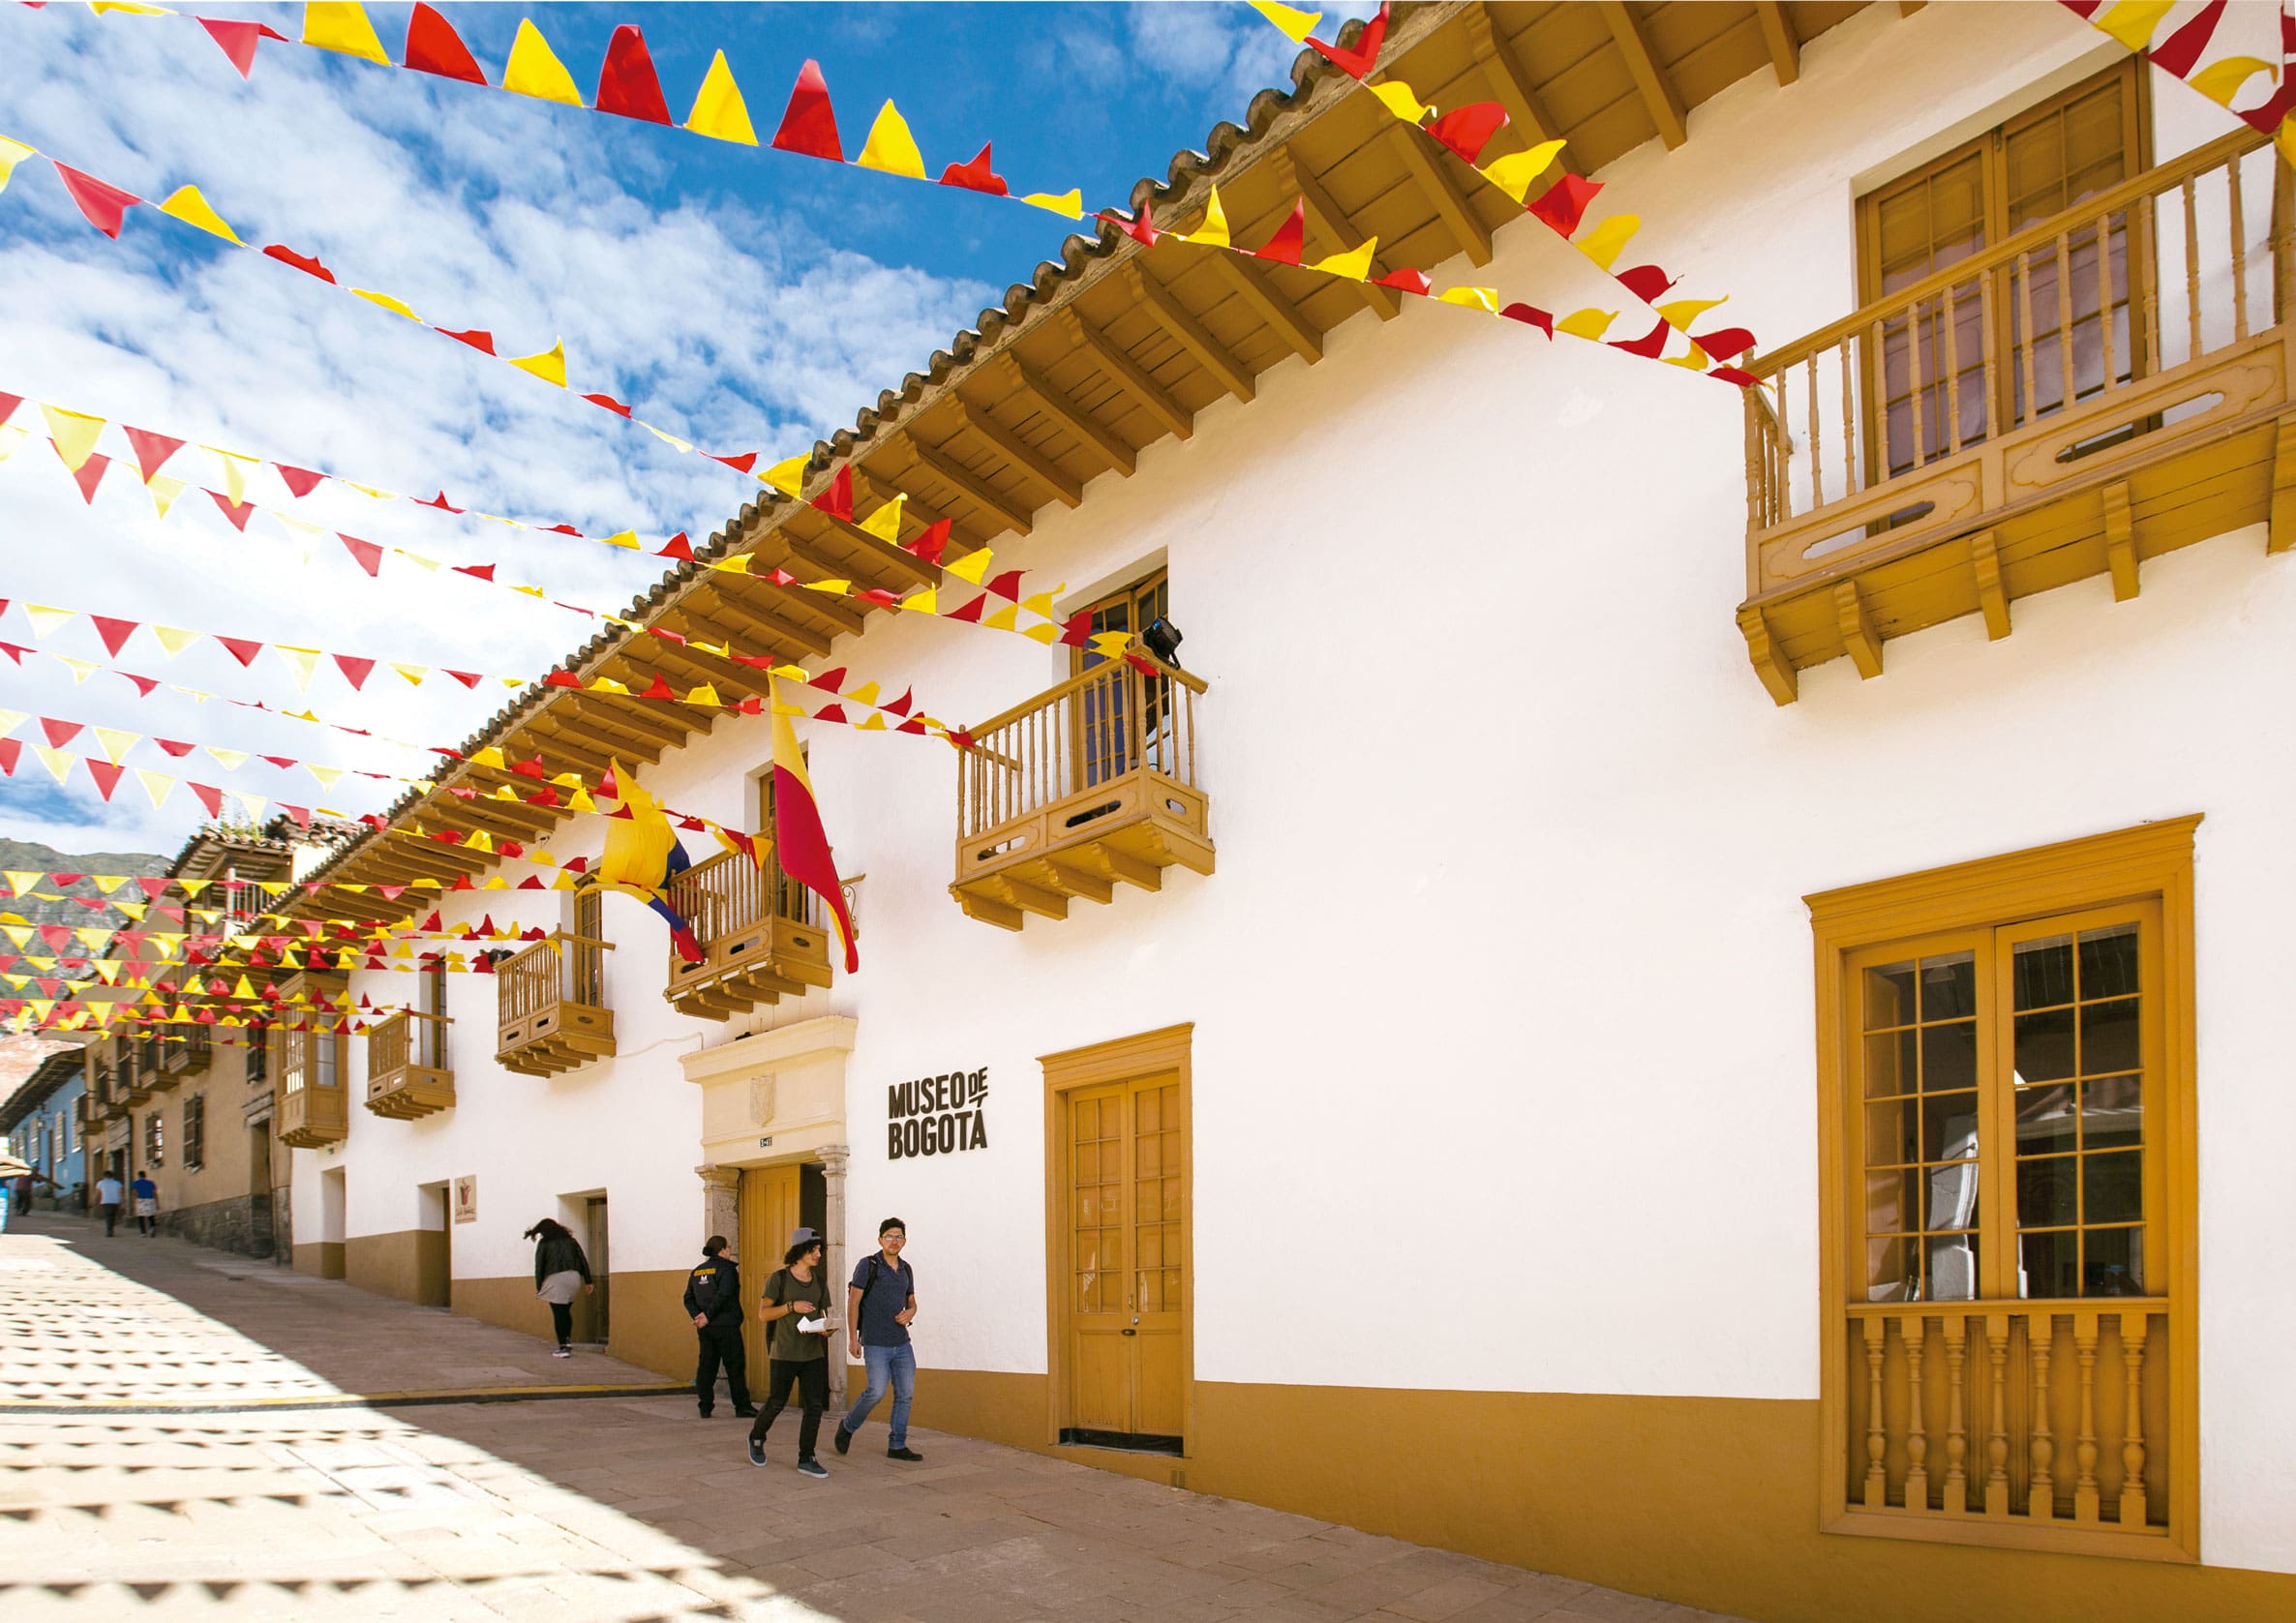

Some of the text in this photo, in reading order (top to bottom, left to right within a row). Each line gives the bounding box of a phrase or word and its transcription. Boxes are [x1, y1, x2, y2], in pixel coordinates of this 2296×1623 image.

[889, 1067, 987, 1119] MUSEO DE
[888, 1100, 988, 1160] BOGOTÁ
